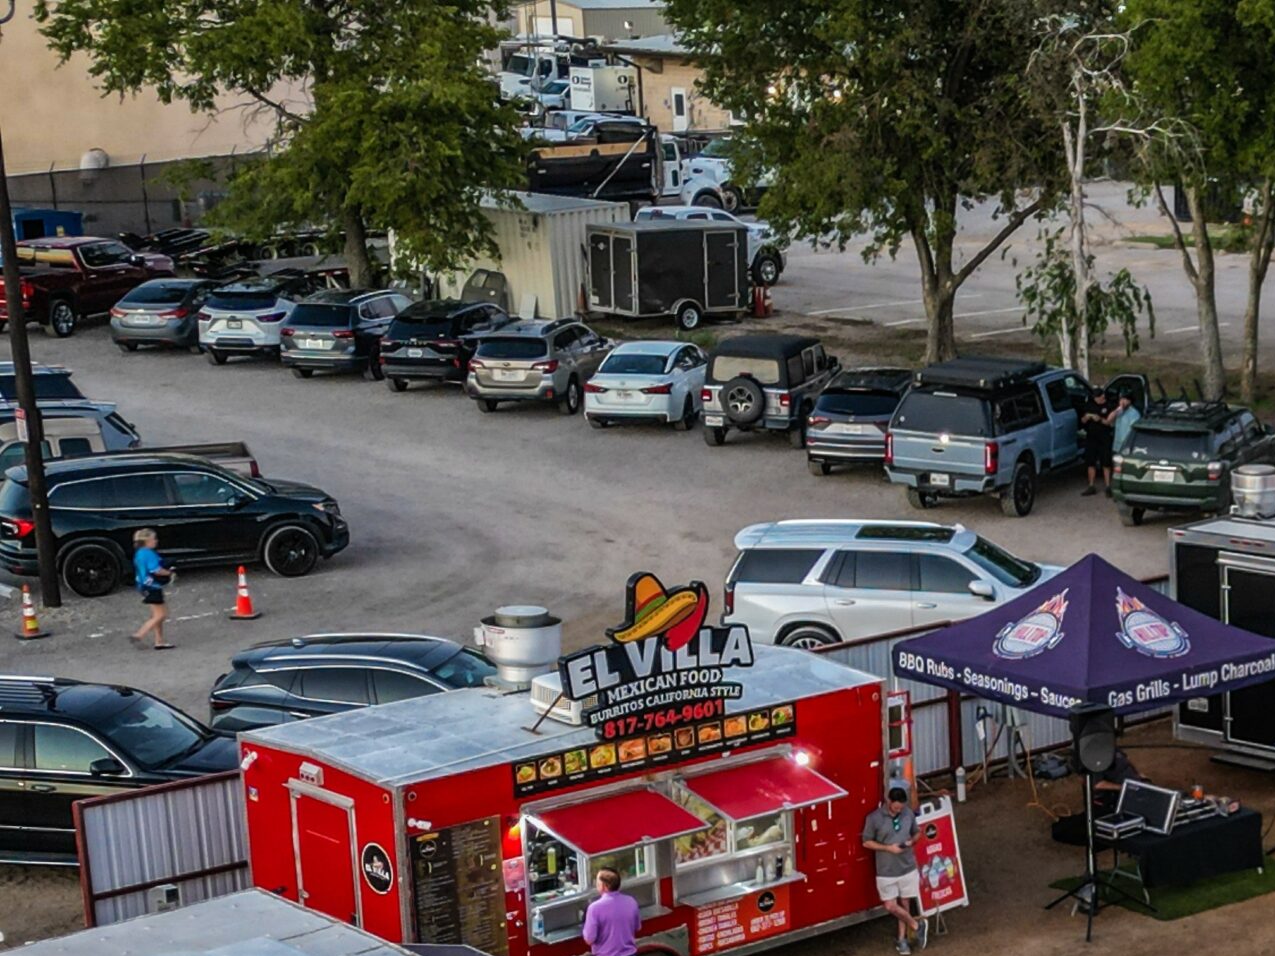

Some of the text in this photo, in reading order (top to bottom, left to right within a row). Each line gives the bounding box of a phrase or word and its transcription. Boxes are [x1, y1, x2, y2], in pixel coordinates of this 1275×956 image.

[567, 625, 753, 699] EL VILLA
[899, 651, 924, 673] BBQ
[926, 658, 955, 680] Rubs
[963, 667, 1028, 701] Seasonings
[1108, 690, 1133, 708] Gas
[1136, 680, 1170, 702] Grills
[1183, 670, 1218, 691] Lump
[1221, 653, 1275, 682] Charcoal
[590, 685, 741, 724] BURRITOS CALIFORNIA STYLE
[607, 669, 722, 704] MEXICAN FOOD
[604, 700, 725, 738] 817-764-9601
